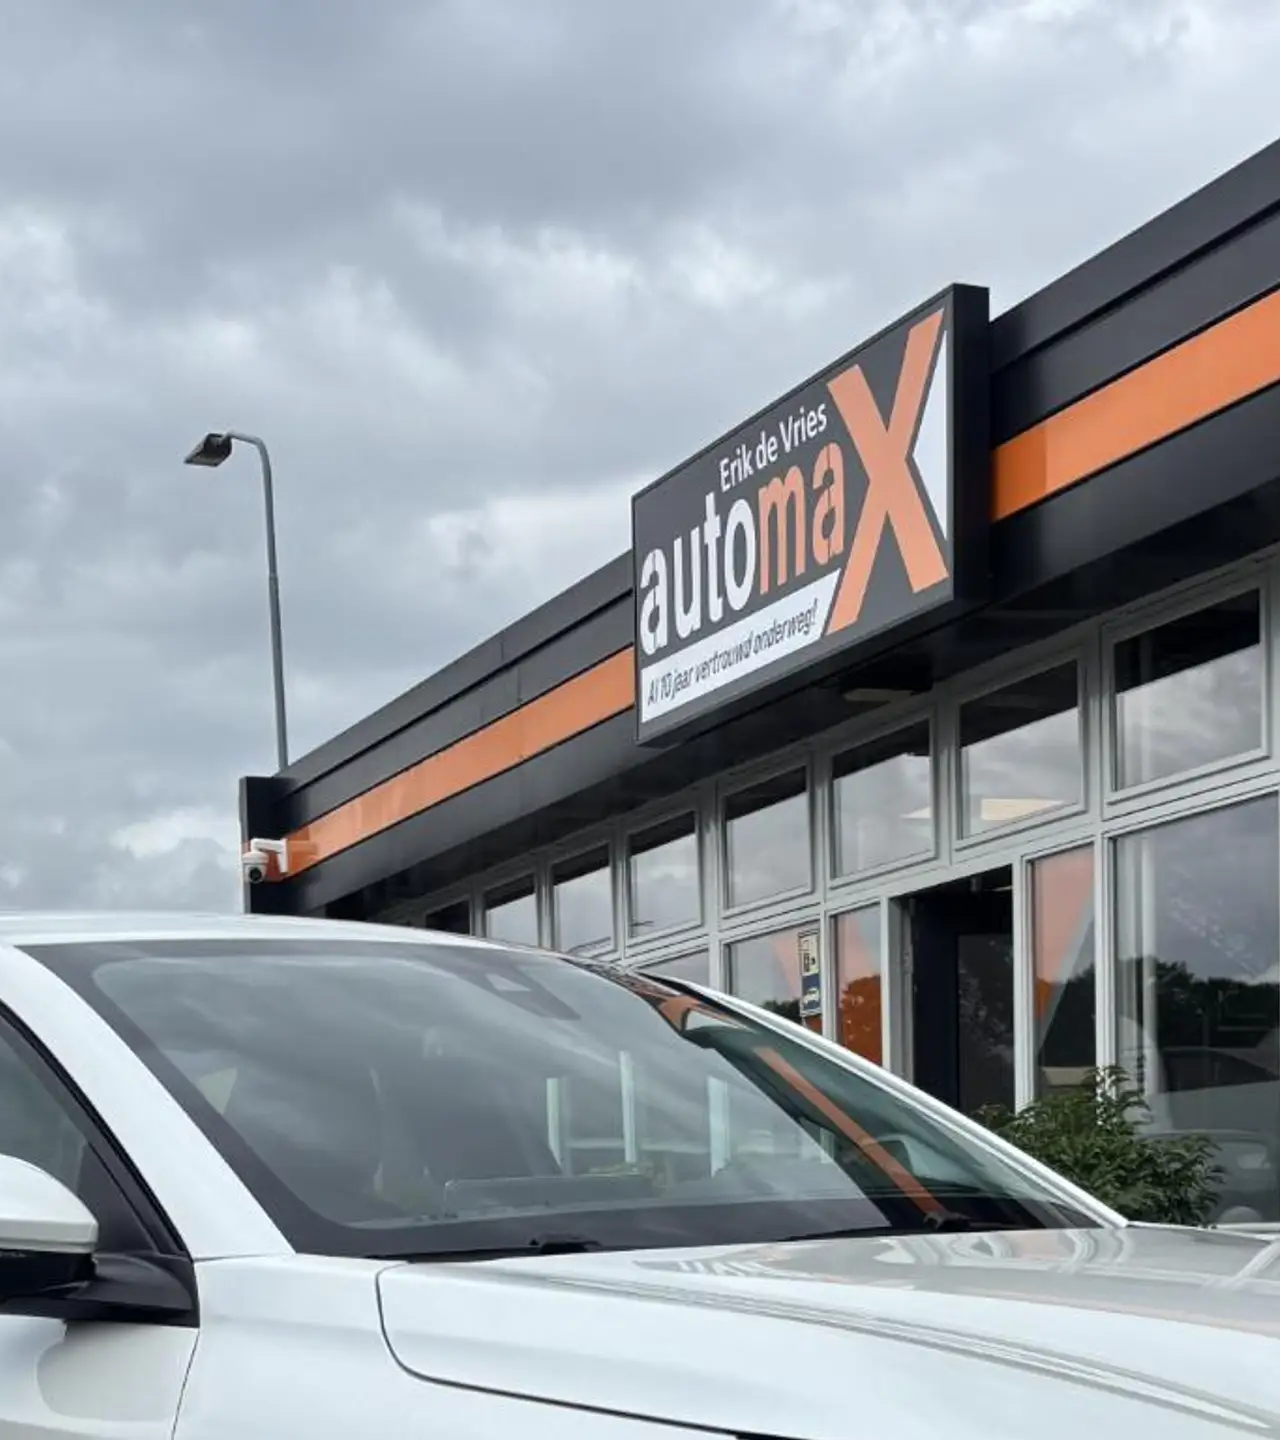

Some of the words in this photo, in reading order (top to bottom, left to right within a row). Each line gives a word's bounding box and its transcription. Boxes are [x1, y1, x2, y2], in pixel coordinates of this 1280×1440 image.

[720, 444, 754, 493] Erik
[756, 430, 779, 469] de
[779, 403, 827, 453] Vries
[671, 666, 695, 699] jaar
[695, 631, 754, 684] vertrouwd
[753, 598, 819, 654] onderweg!
